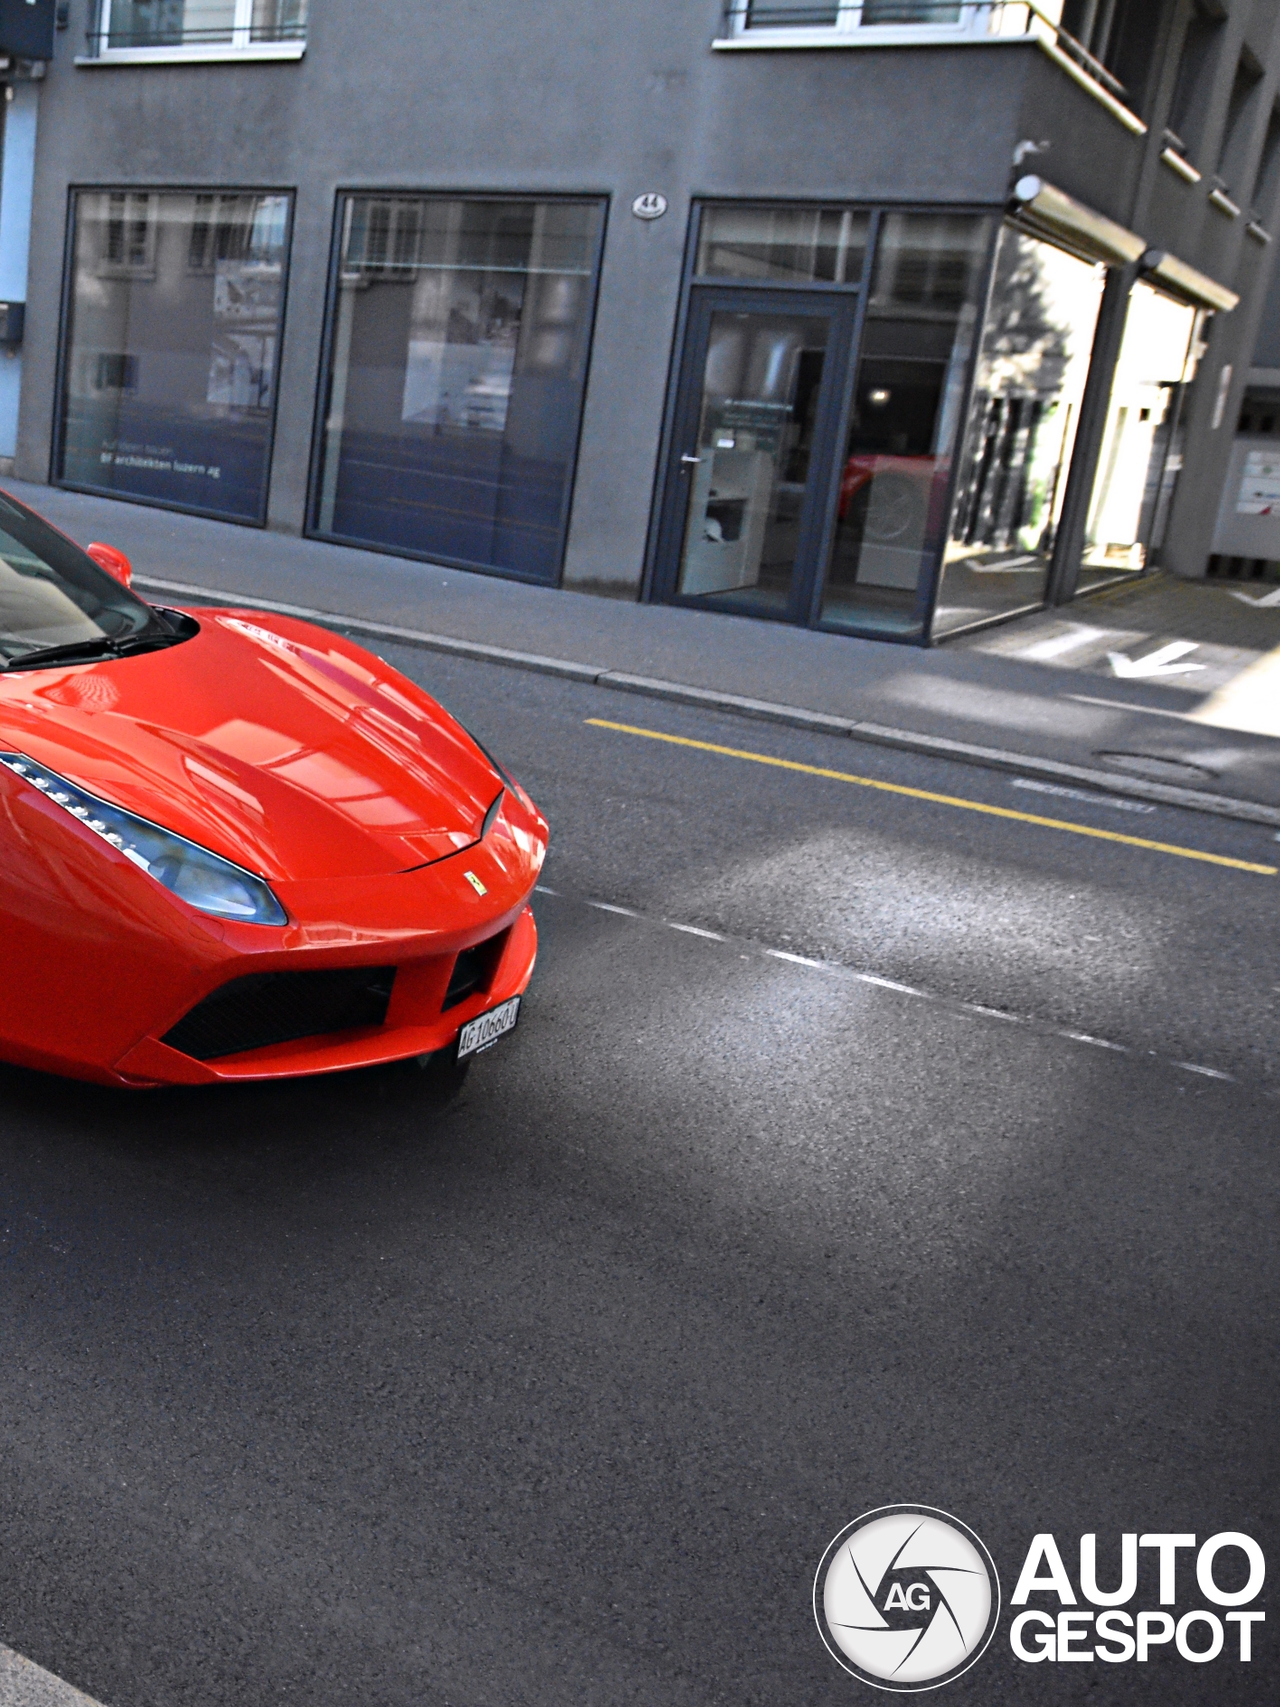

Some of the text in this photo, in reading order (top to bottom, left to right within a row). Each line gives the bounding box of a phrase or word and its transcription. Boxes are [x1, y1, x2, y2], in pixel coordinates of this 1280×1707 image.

[642, 195, 658, 208] 44
[114, 455, 172, 470] architekten
[173, 460, 206, 475] luzern
[207, 466, 221, 480] ag
